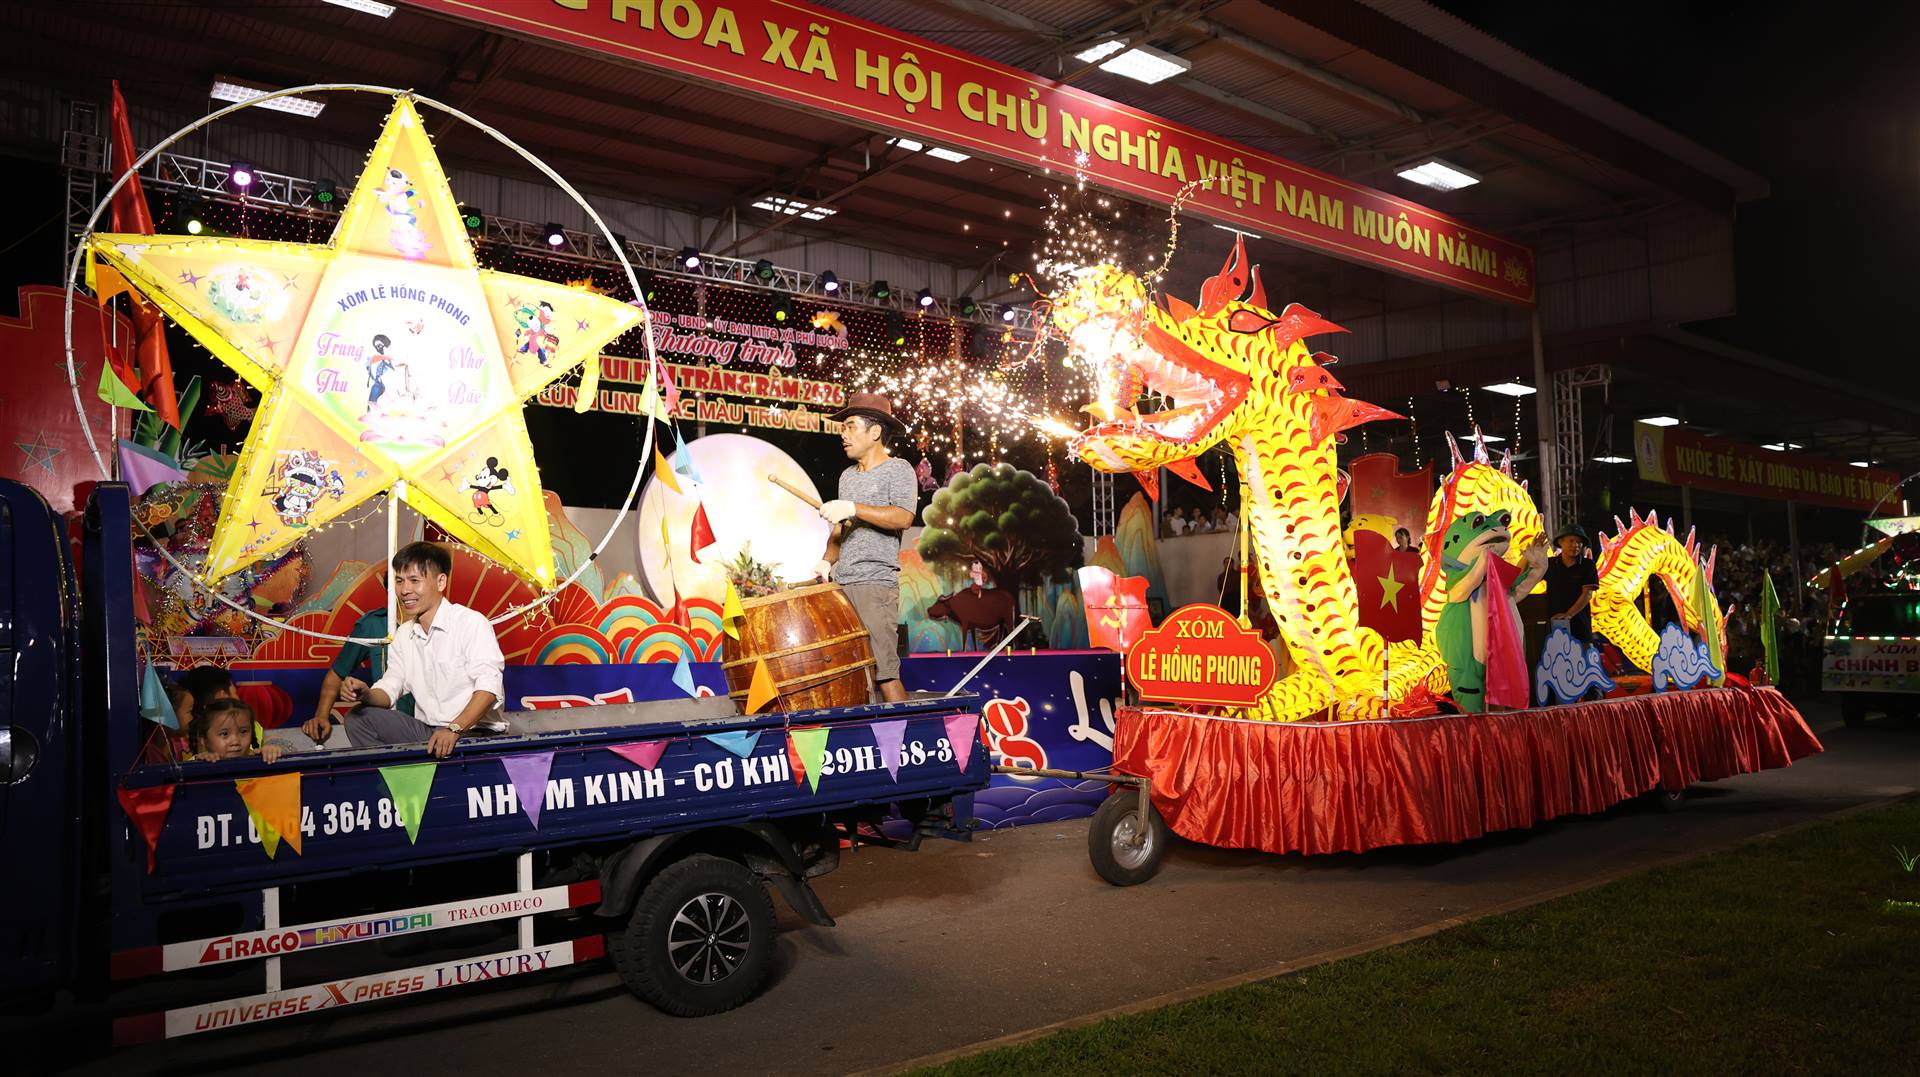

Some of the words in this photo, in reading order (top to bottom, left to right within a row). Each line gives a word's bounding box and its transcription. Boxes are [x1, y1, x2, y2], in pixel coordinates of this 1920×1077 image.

[760, 21, 838, 81] XÃ
[855, 48, 942, 113] HỘI
[957, 82, 1048, 139] CHỦ
[1061, 112, 1187, 183] NGHĨA
[1196, 157, 1266, 209] VIỆT
[1275, 180, 1344, 230] NAM
[1353, 212, 1431, 257] MUÔN
[1438, 232, 1498, 278] NĂM!
[429, 294, 470, 326] PHONG
[317, 332, 364, 362] Trung
[678, 314, 706, 330] UBND
[729, 322, 751, 337] BAN
[752, 325, 778, 341] MTTQ
[796, 330, 815, 345] PHÚ
[317, 369, 348, 394] Thu
[599, 356, 630, 381] UI
[680, 364, 751, 396] TRĂNG
[600, 390, 642, 414] LIN
[698, 398, 743, 425] MÀU
[1176, 616, 1224, 638] XÓM
[1140, 648, 1157, 681] LÊ
[1161, 645, 1202, 683] HỒNG
[1206, 655, 1261, 686] PHONG
[1835, 656, 1898, 671] CHÍNH
[467, 778, 575, 819] NHM
[584, 768, 665, 805] KINH
[694, 757, 734, 792] CƠ
[741, 748, 790, 786] KHÍ
[197, 814, 242, 849] ĐT.
[323, 801, 371, 835] 364
[315, 913, 432, 944] HYUNDAI
[448, 896, 543, 922] TRACOMECO
[195, 995, 312, 1031] UNIVERSE
[435, 950, 551, 988] LUXURY
